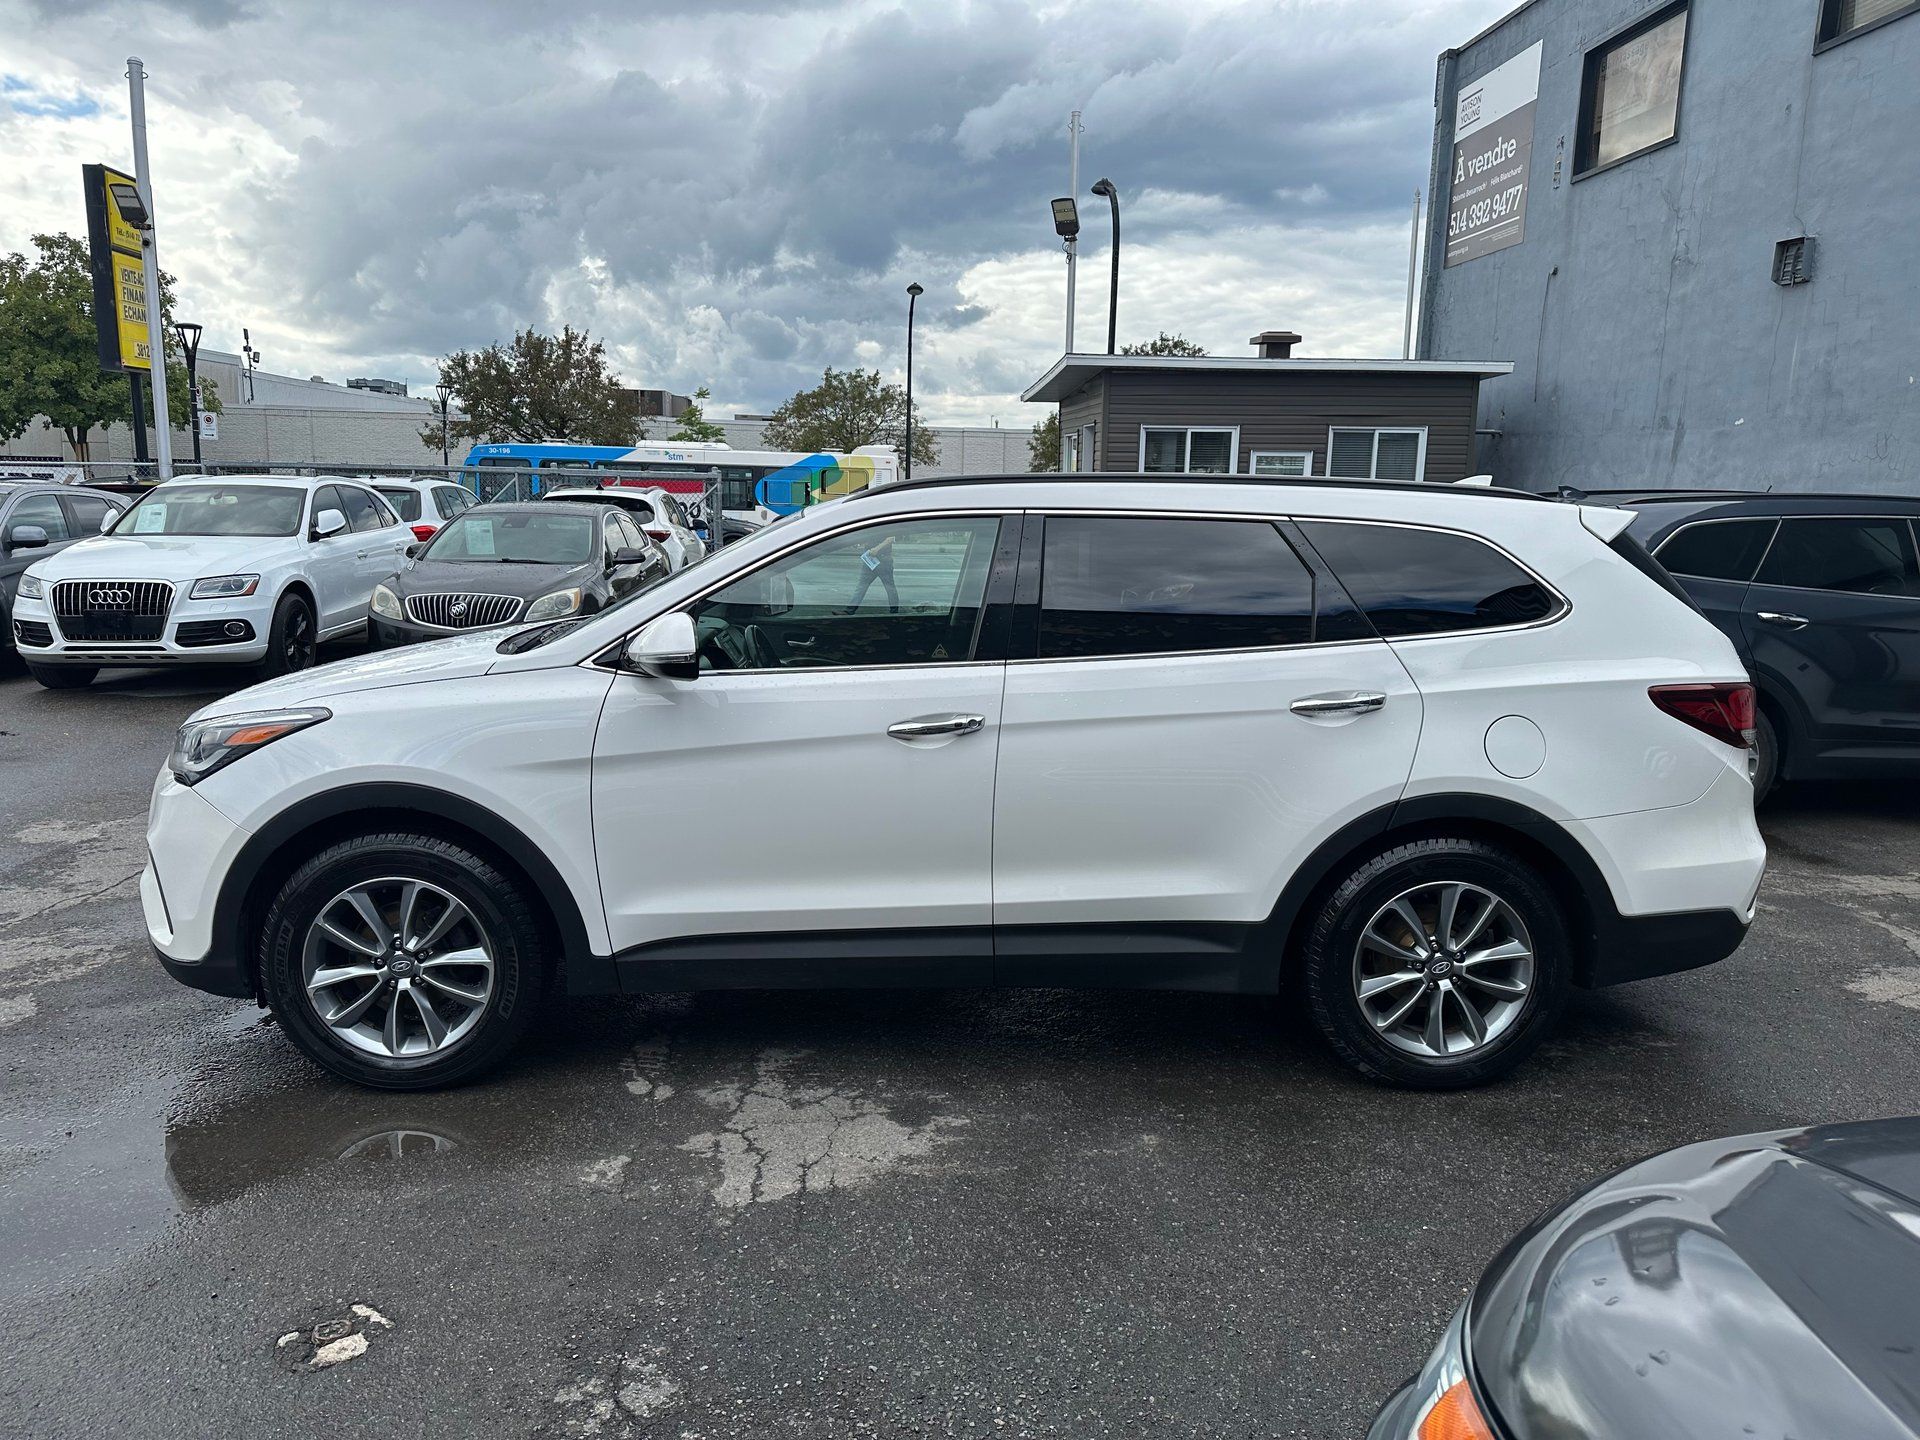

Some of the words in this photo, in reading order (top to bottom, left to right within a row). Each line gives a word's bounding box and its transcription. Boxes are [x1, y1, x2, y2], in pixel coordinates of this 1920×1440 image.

[1461, 94, 1483, 114] AVISON
[1460, 106, 1481, 125] YOUNG
[1454, 149, 1466, 184] À
[1468, 136, 1517, 177] vendre
[1449, 208, 1467, 236] 514
[1469, 197, 1491, 230] 392
[1492, 183, 1523, 220] 9477
[668, 452, 684, 461] stm
